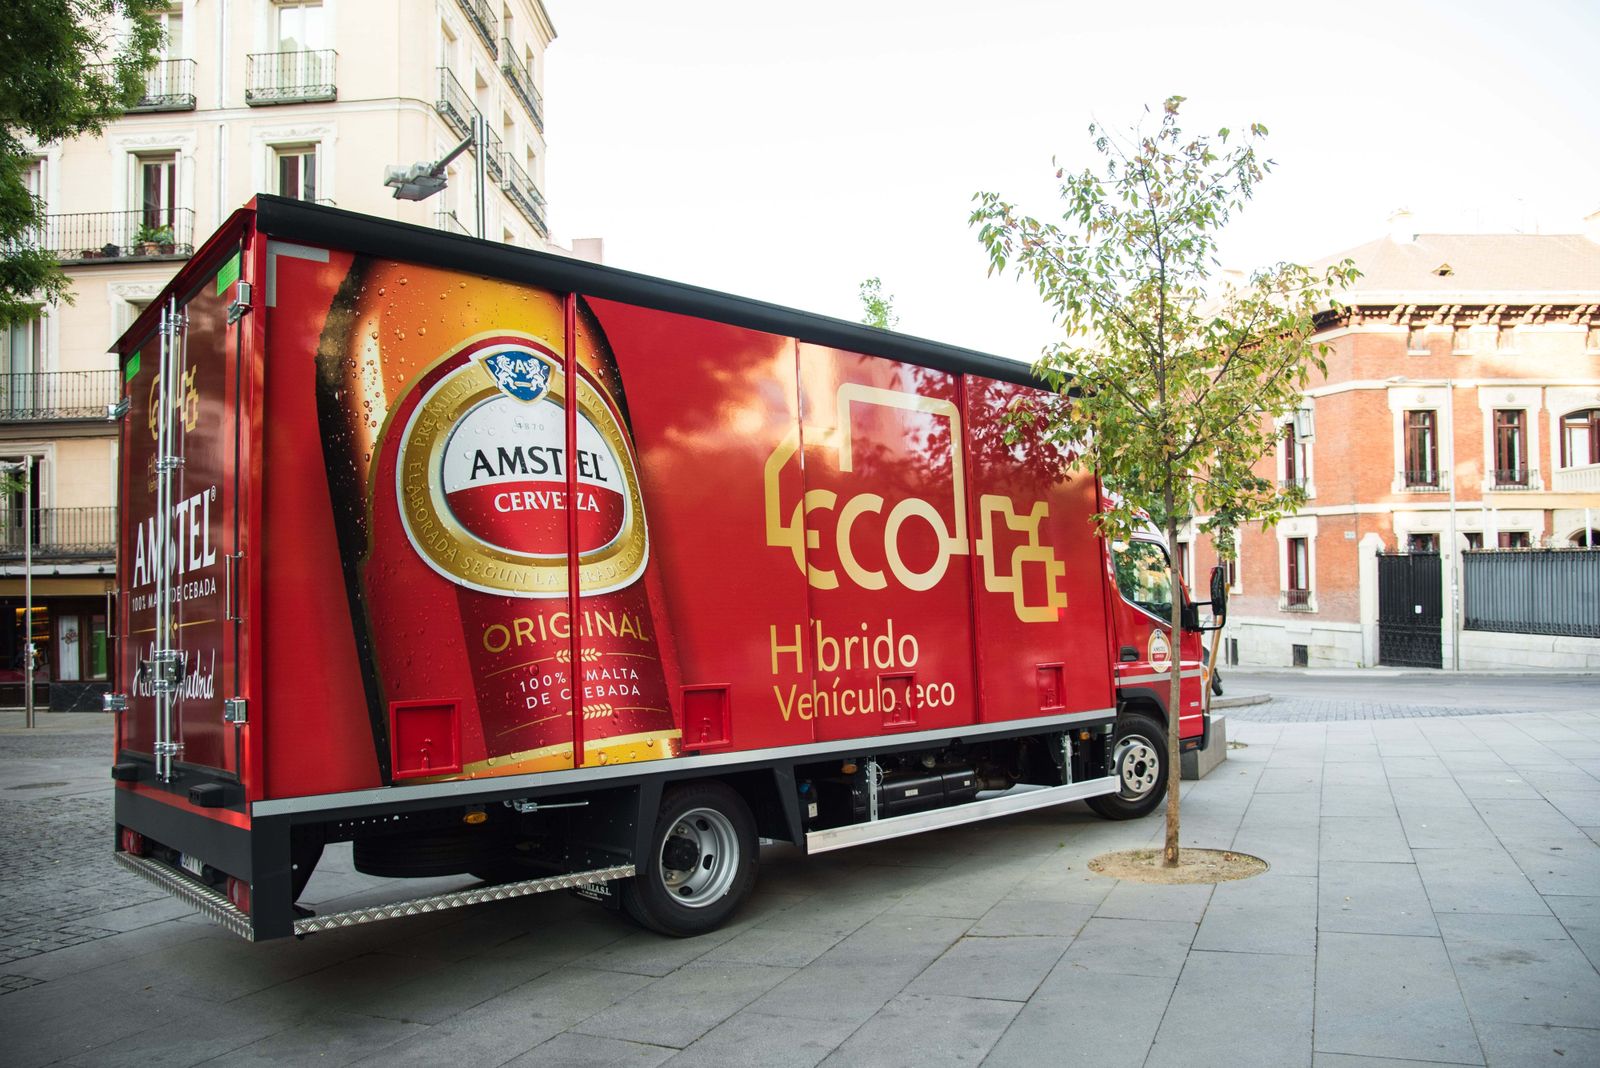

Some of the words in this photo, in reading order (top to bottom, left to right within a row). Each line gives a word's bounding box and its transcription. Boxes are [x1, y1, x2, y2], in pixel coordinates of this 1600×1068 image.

[413, 375, 480, 447] PREMIUM
[470, 446, 608, 482] AMSTEL
[494, 491, 600, 513] CERVEZA
[407, 462, 458, 562] ELABORADA
[536, 573, 559, 586] LA
[183, 576, 216, 600] CEBADA
[482, 611, 649, 653] ORIGINAL
[769, 618, 919, 675] Hbrido
[519, 672, 566, 693] 100%
[586, 668, 639, 682] MALTA
[526, 692, 551, 709] DE
[560, 684, 641, 700] CEBADA
